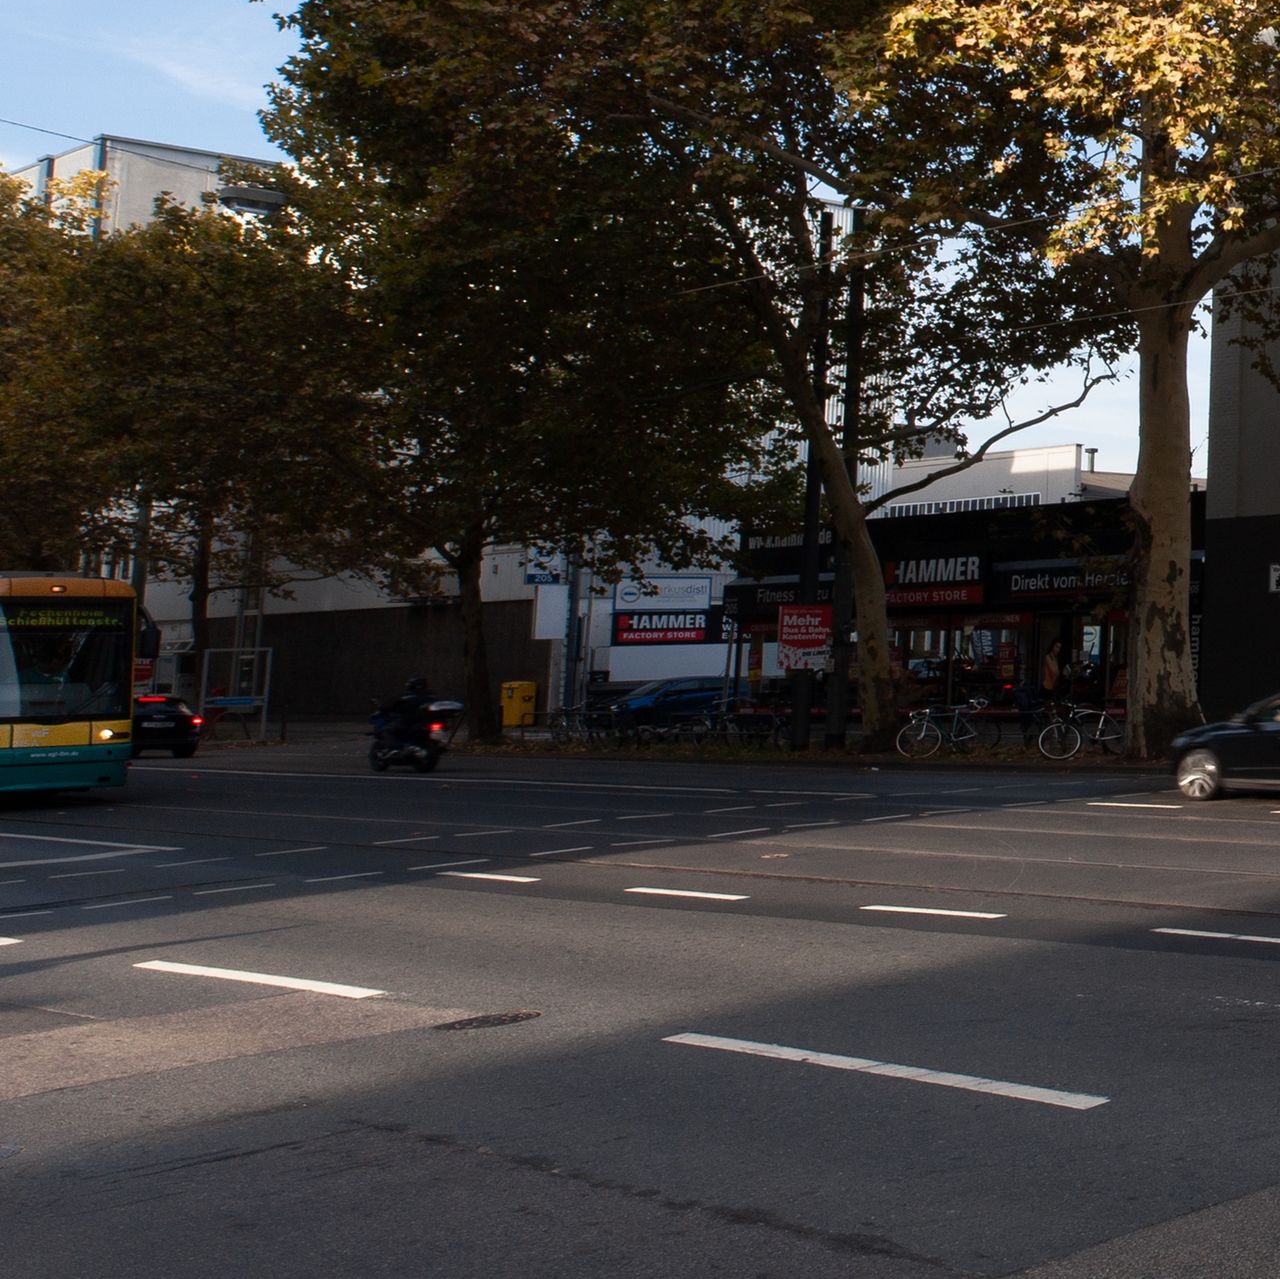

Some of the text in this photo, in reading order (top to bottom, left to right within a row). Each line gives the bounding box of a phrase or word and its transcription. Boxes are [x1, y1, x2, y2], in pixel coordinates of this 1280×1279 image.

[887, 556, 981, 585] HAMMER
[1011, 573, 1050, 593] Direkt
[757, 588, 795, 603] Fitness
[886, 589, 969, 604] FACTORY STORE
[618, 613, 706, 631] HAMMER
[783, 614, 822, 626] Mehr
[623, 630, 697, 641] FACTORY STORE
[783, 632, 826, 641] Kostenfrei
[1190, 613, 1203, 685] hamme
